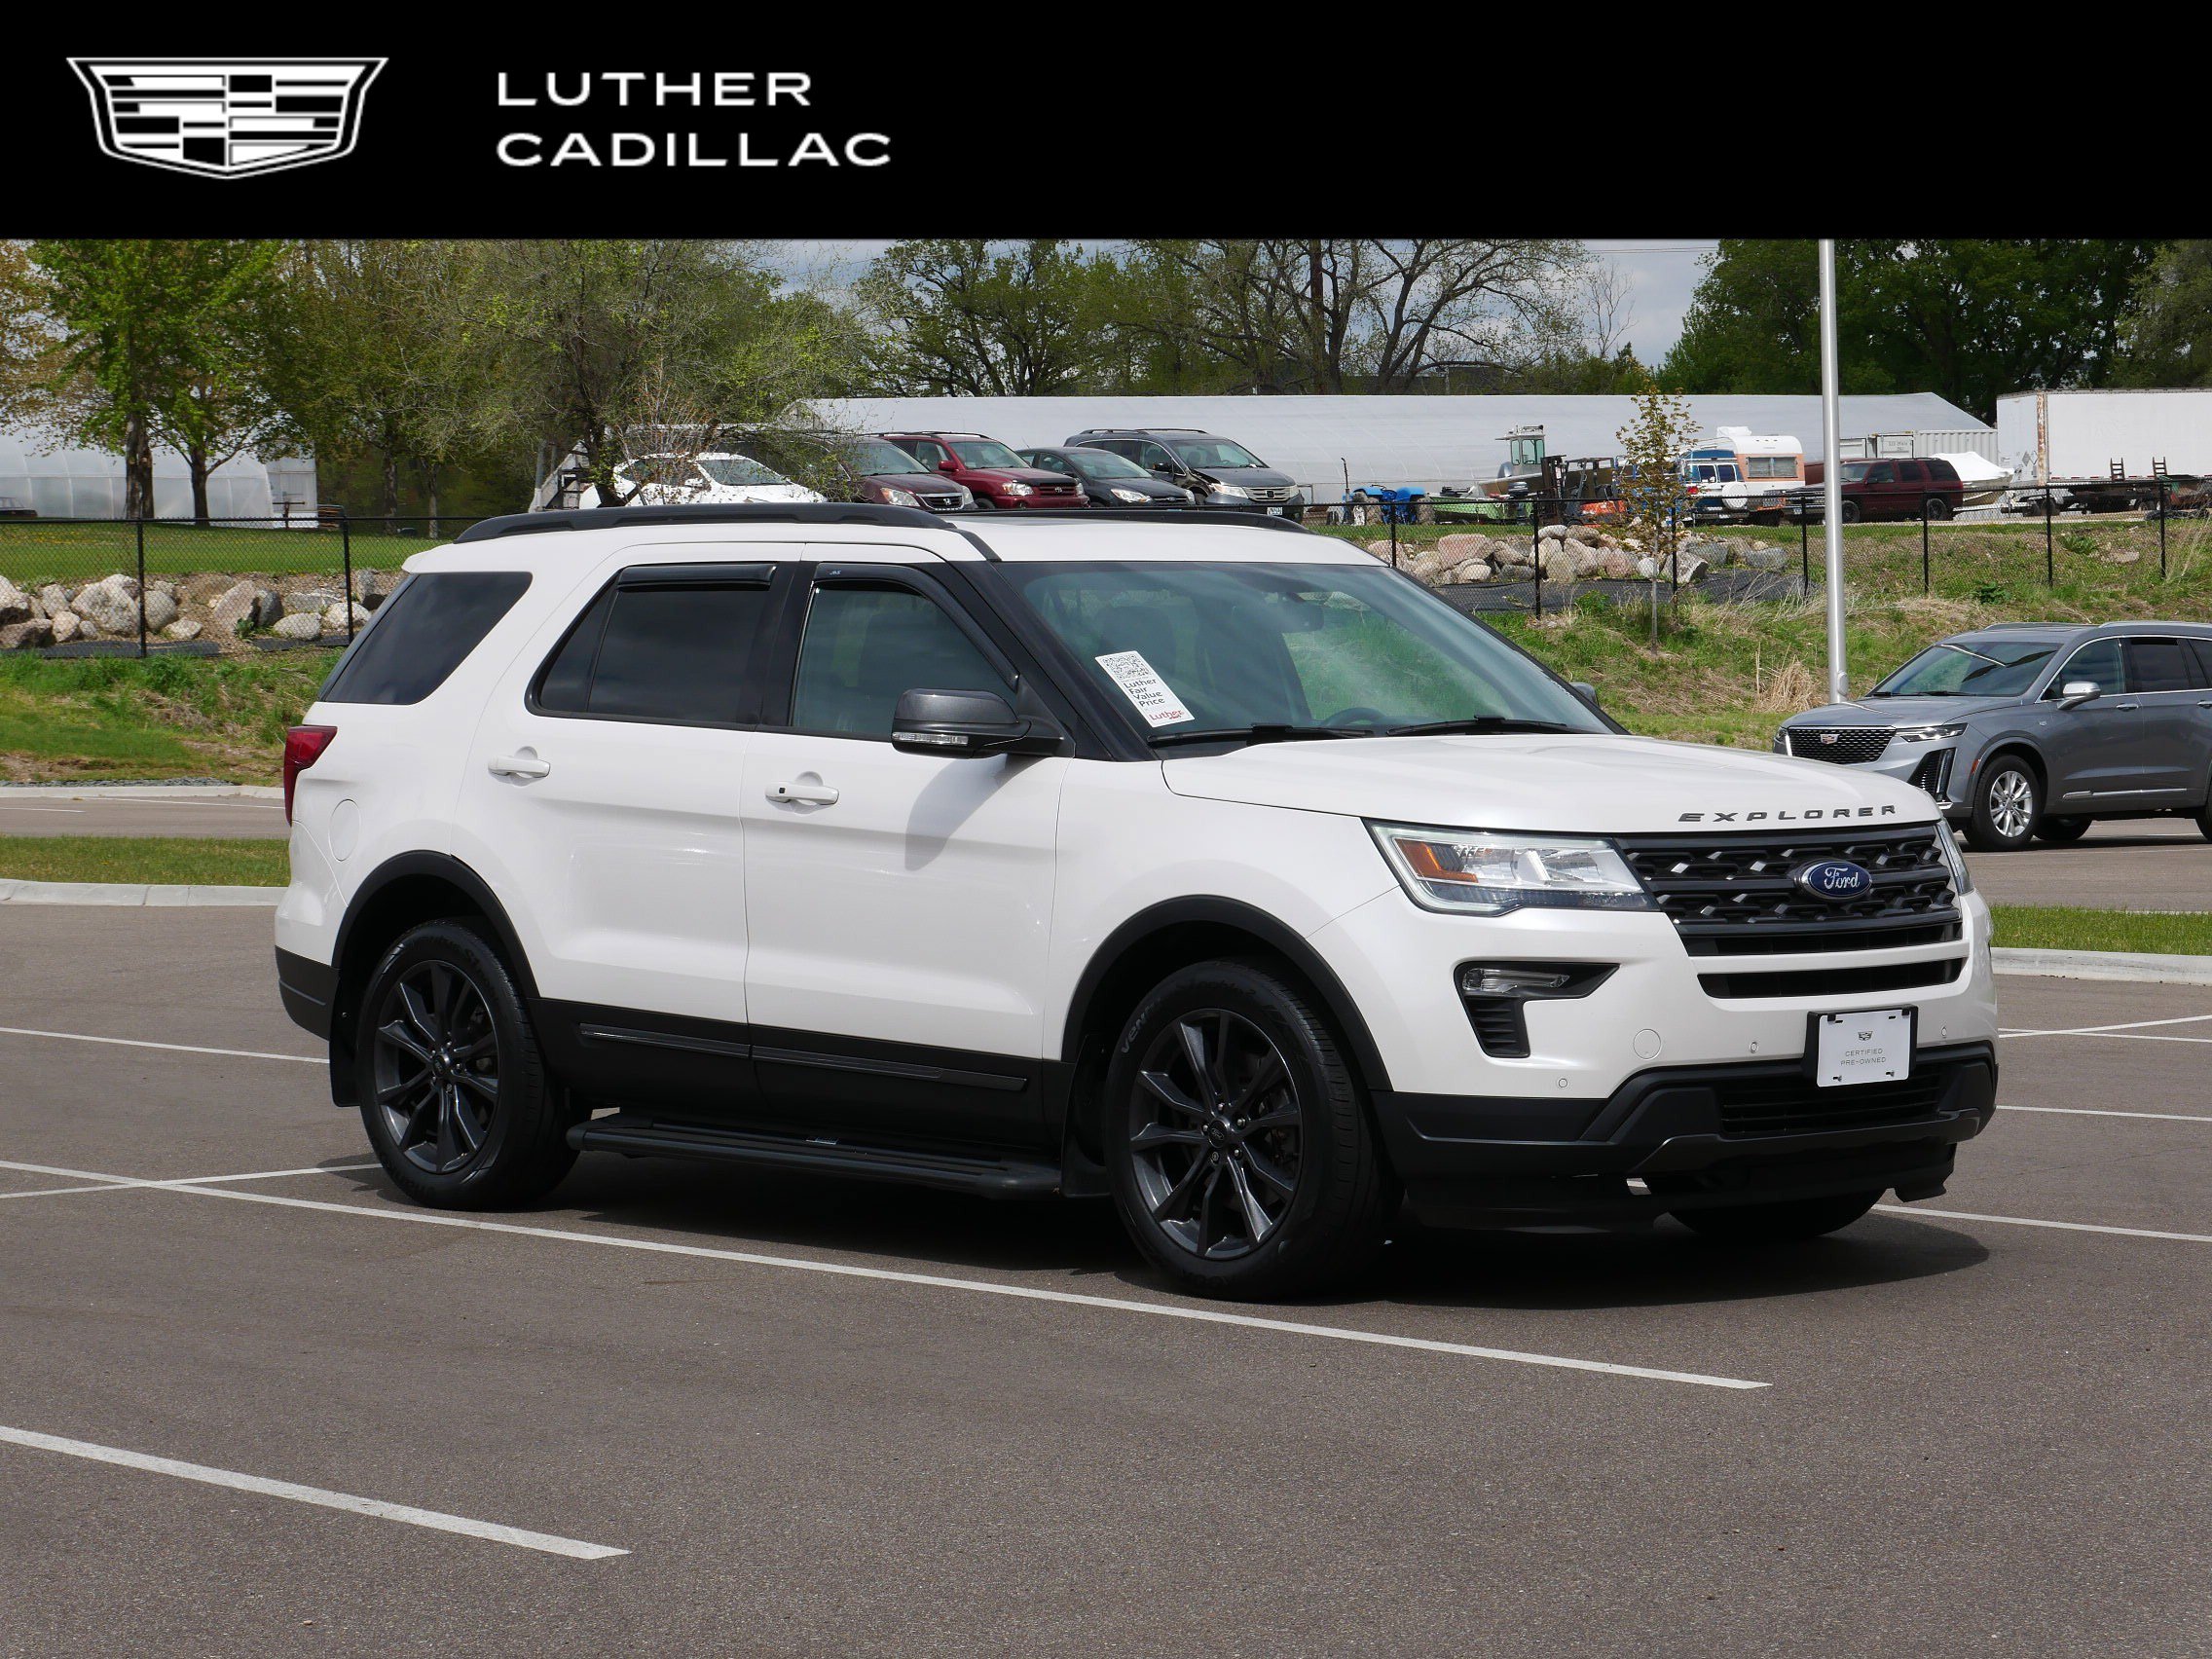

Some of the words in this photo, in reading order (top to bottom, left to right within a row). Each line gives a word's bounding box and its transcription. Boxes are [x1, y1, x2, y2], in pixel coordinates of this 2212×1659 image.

[1124, 680, 1157, 688] Luther
[1133, 691, 1163, 700] Value
[1138, 698, 1165, 707] Price
[1149, 710, 1183, 720] Luther
[1677, 804, 1897, 823] EXPLORER
[1824, 866, 1861, 890] Ford
[1845, 1048, 1883, 1057] CERTIFIED
[1840, 1056, 1887, 1066] PRE-OWNED
